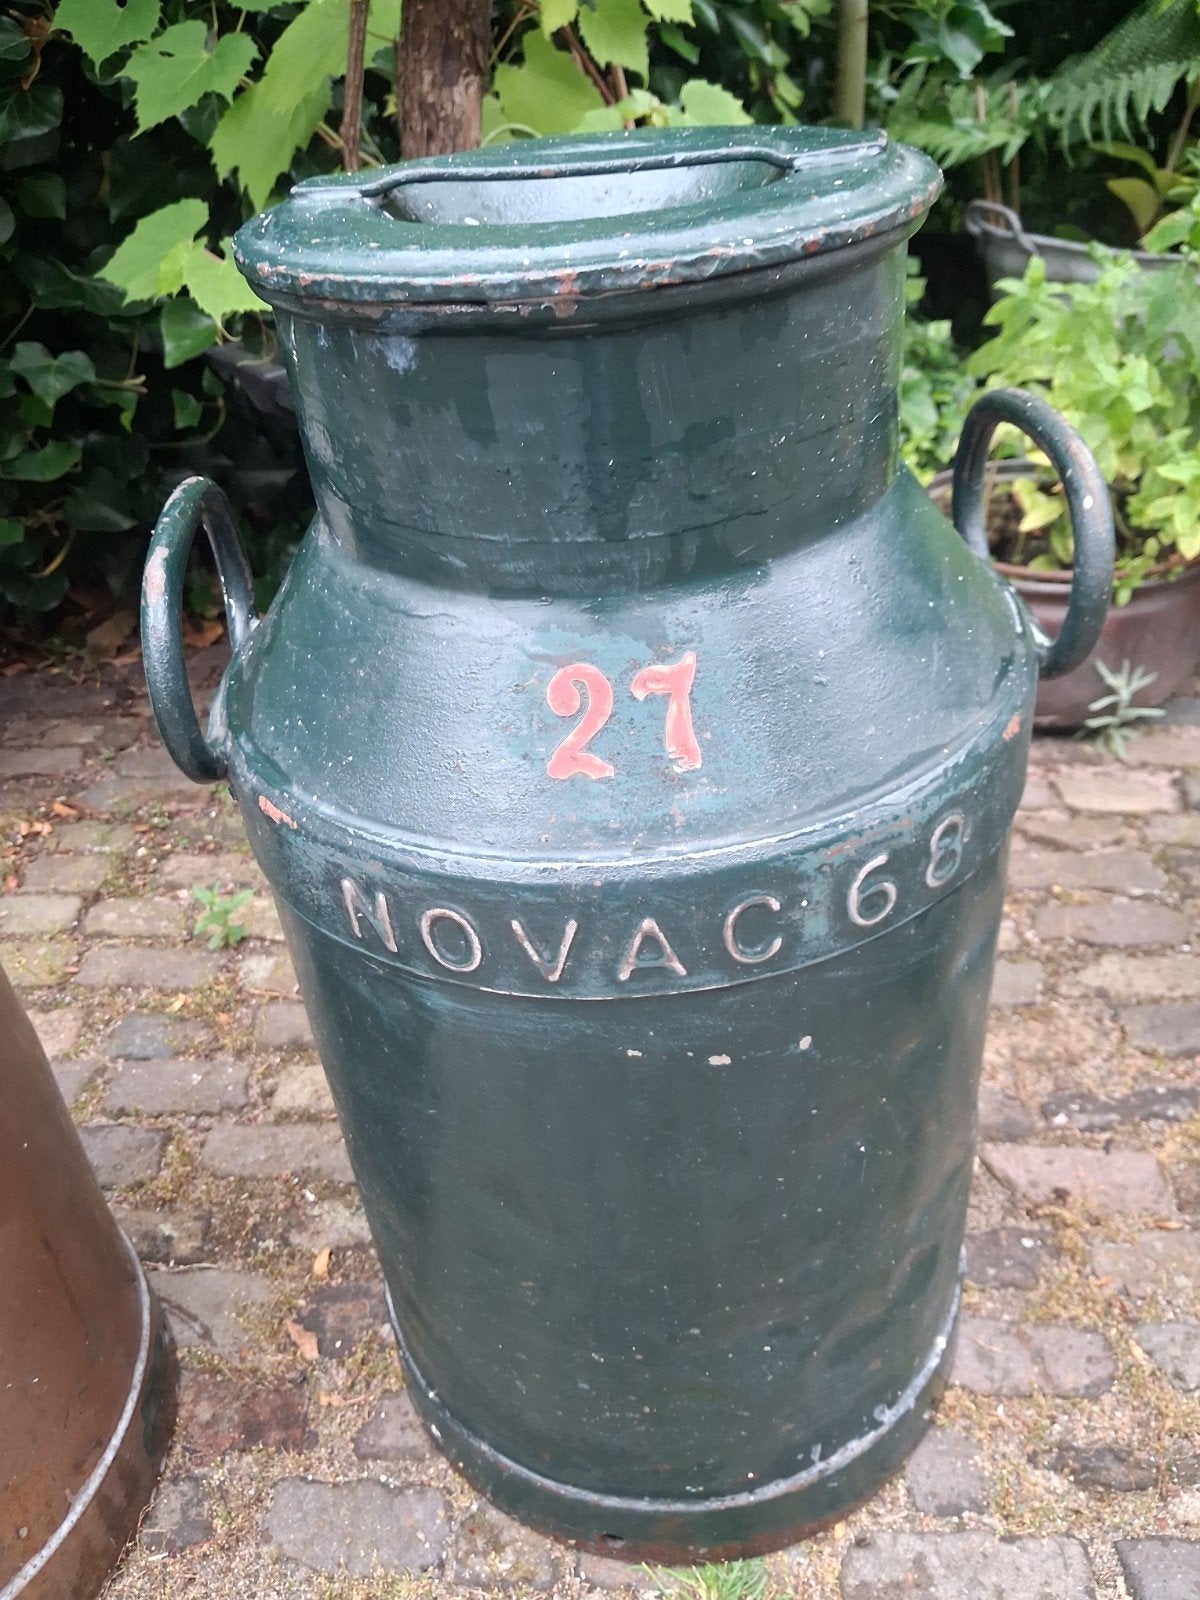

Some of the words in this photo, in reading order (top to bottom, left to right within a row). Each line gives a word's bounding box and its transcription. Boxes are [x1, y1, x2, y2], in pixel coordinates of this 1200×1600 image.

[546, 651, 702, 780] 27
[340, 877, 783, 982] NOVAC
[849, 812, 966, 927] 68
